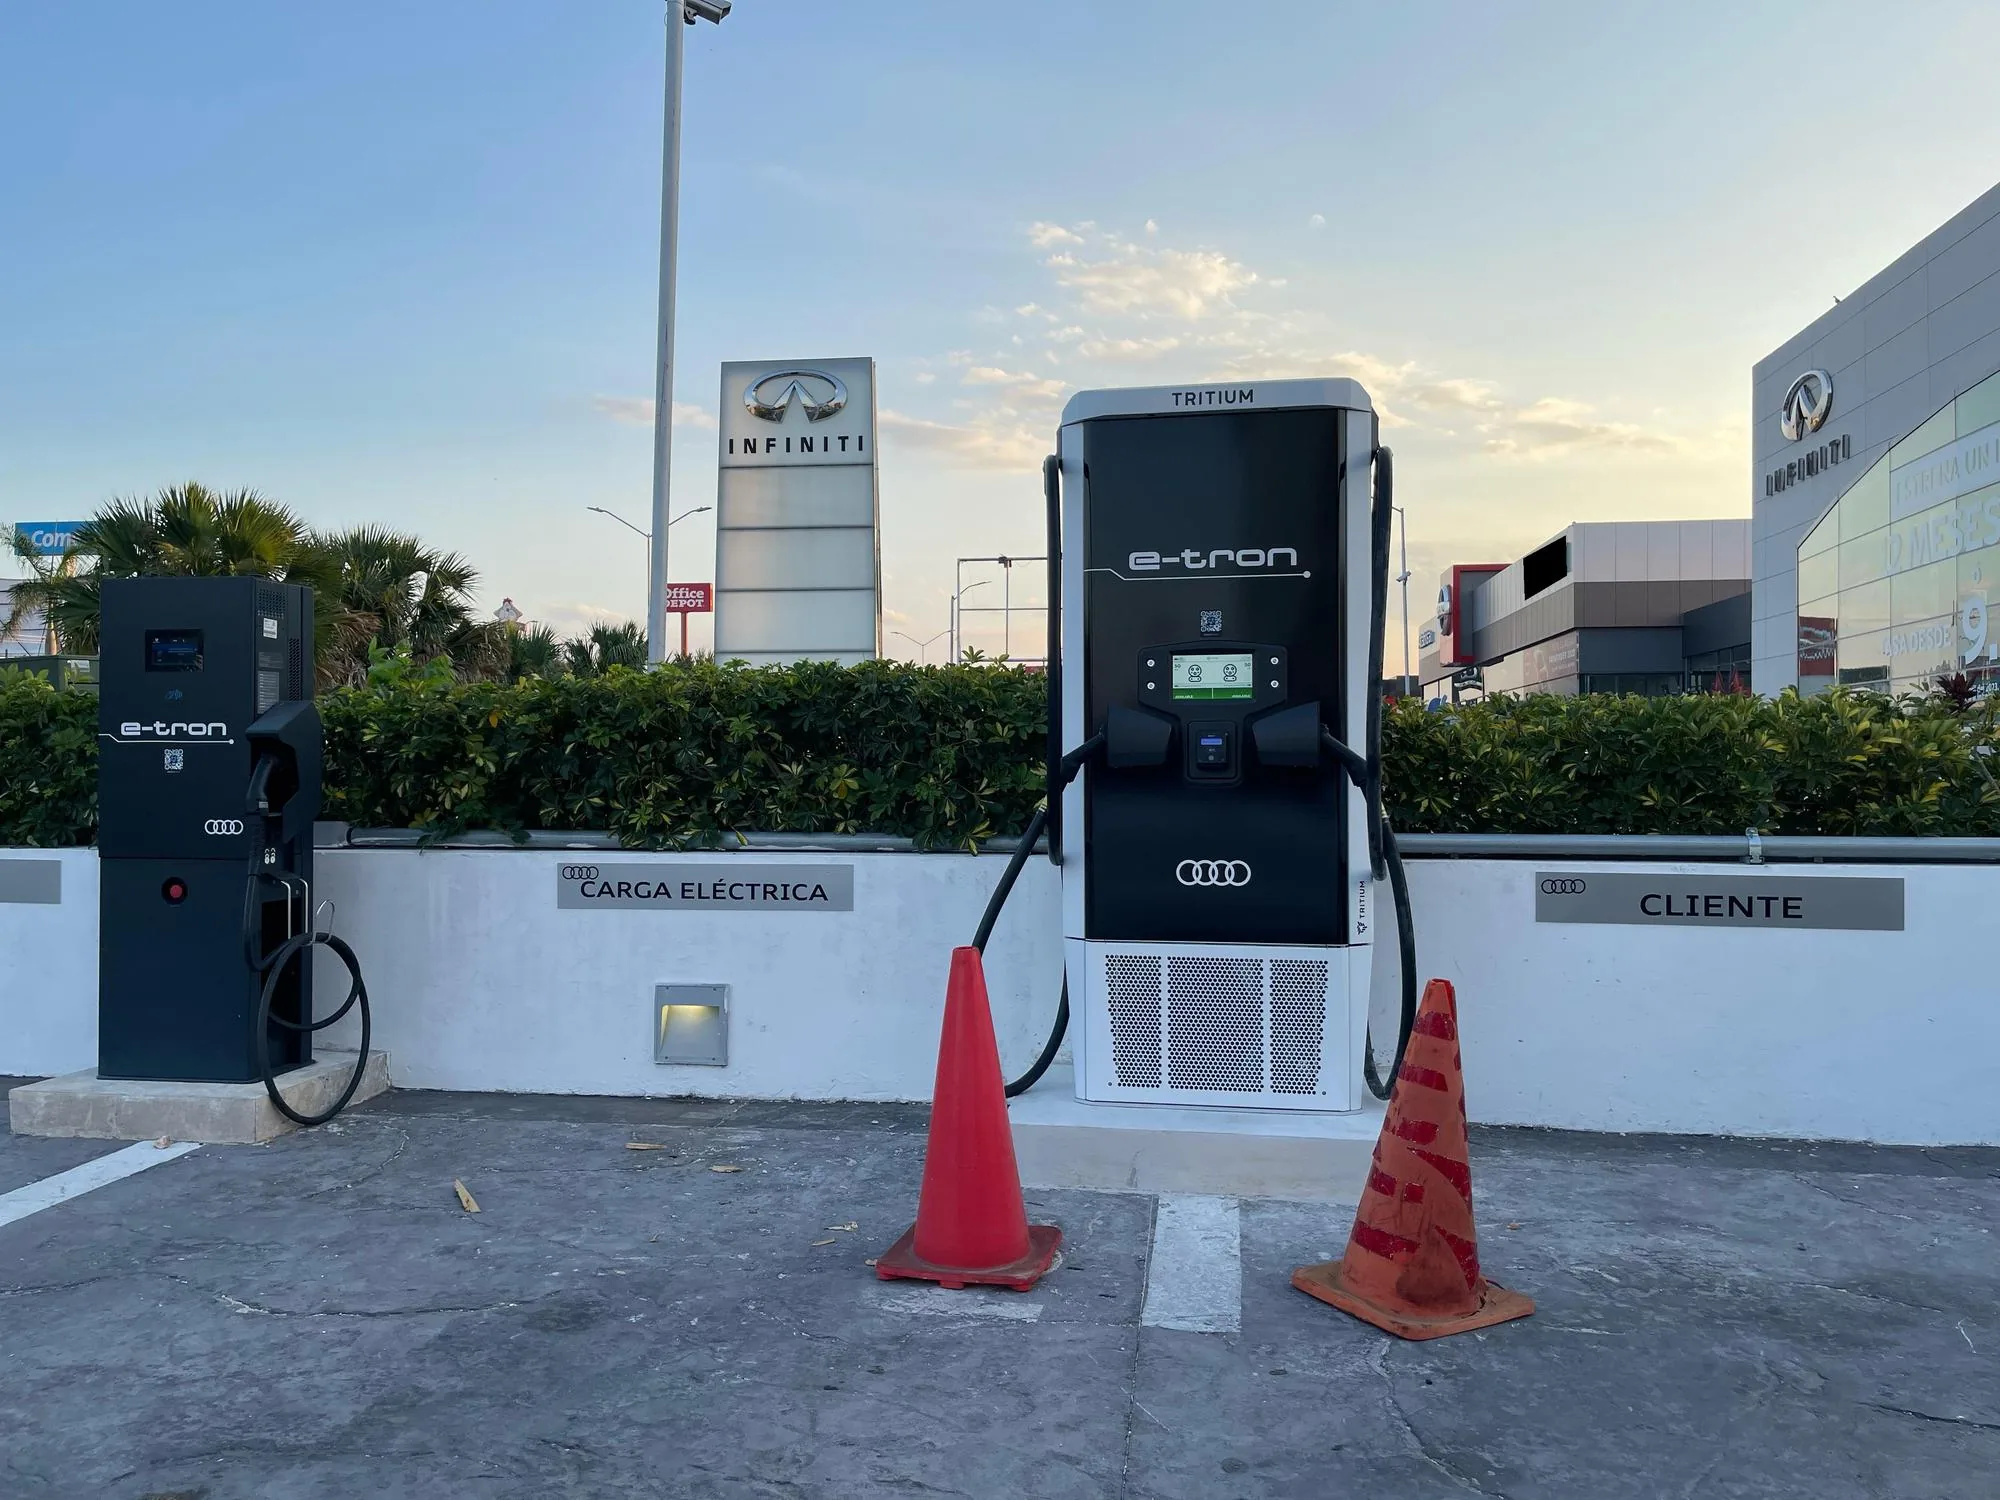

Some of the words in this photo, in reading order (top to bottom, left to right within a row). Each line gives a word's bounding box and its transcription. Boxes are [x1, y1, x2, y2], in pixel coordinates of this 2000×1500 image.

[1172, 389, 1254, 406] TRITIUM
[728, 435, 864, 454] INFINITI
[1766, 433, 1851, 496] INFINITI
[1965, 441, 1989, 475] UN
[1128, 548, 1297, 571] e-tron
[1911, 623, 1954, 654] DESDE
[121, 721, 227, 736] e-tron
[580, 881, 673, 899] CARGA
[680, 878, 829, 901] ELÉCTRICA
[1640, 893, 1803, 919] CLIENTE
